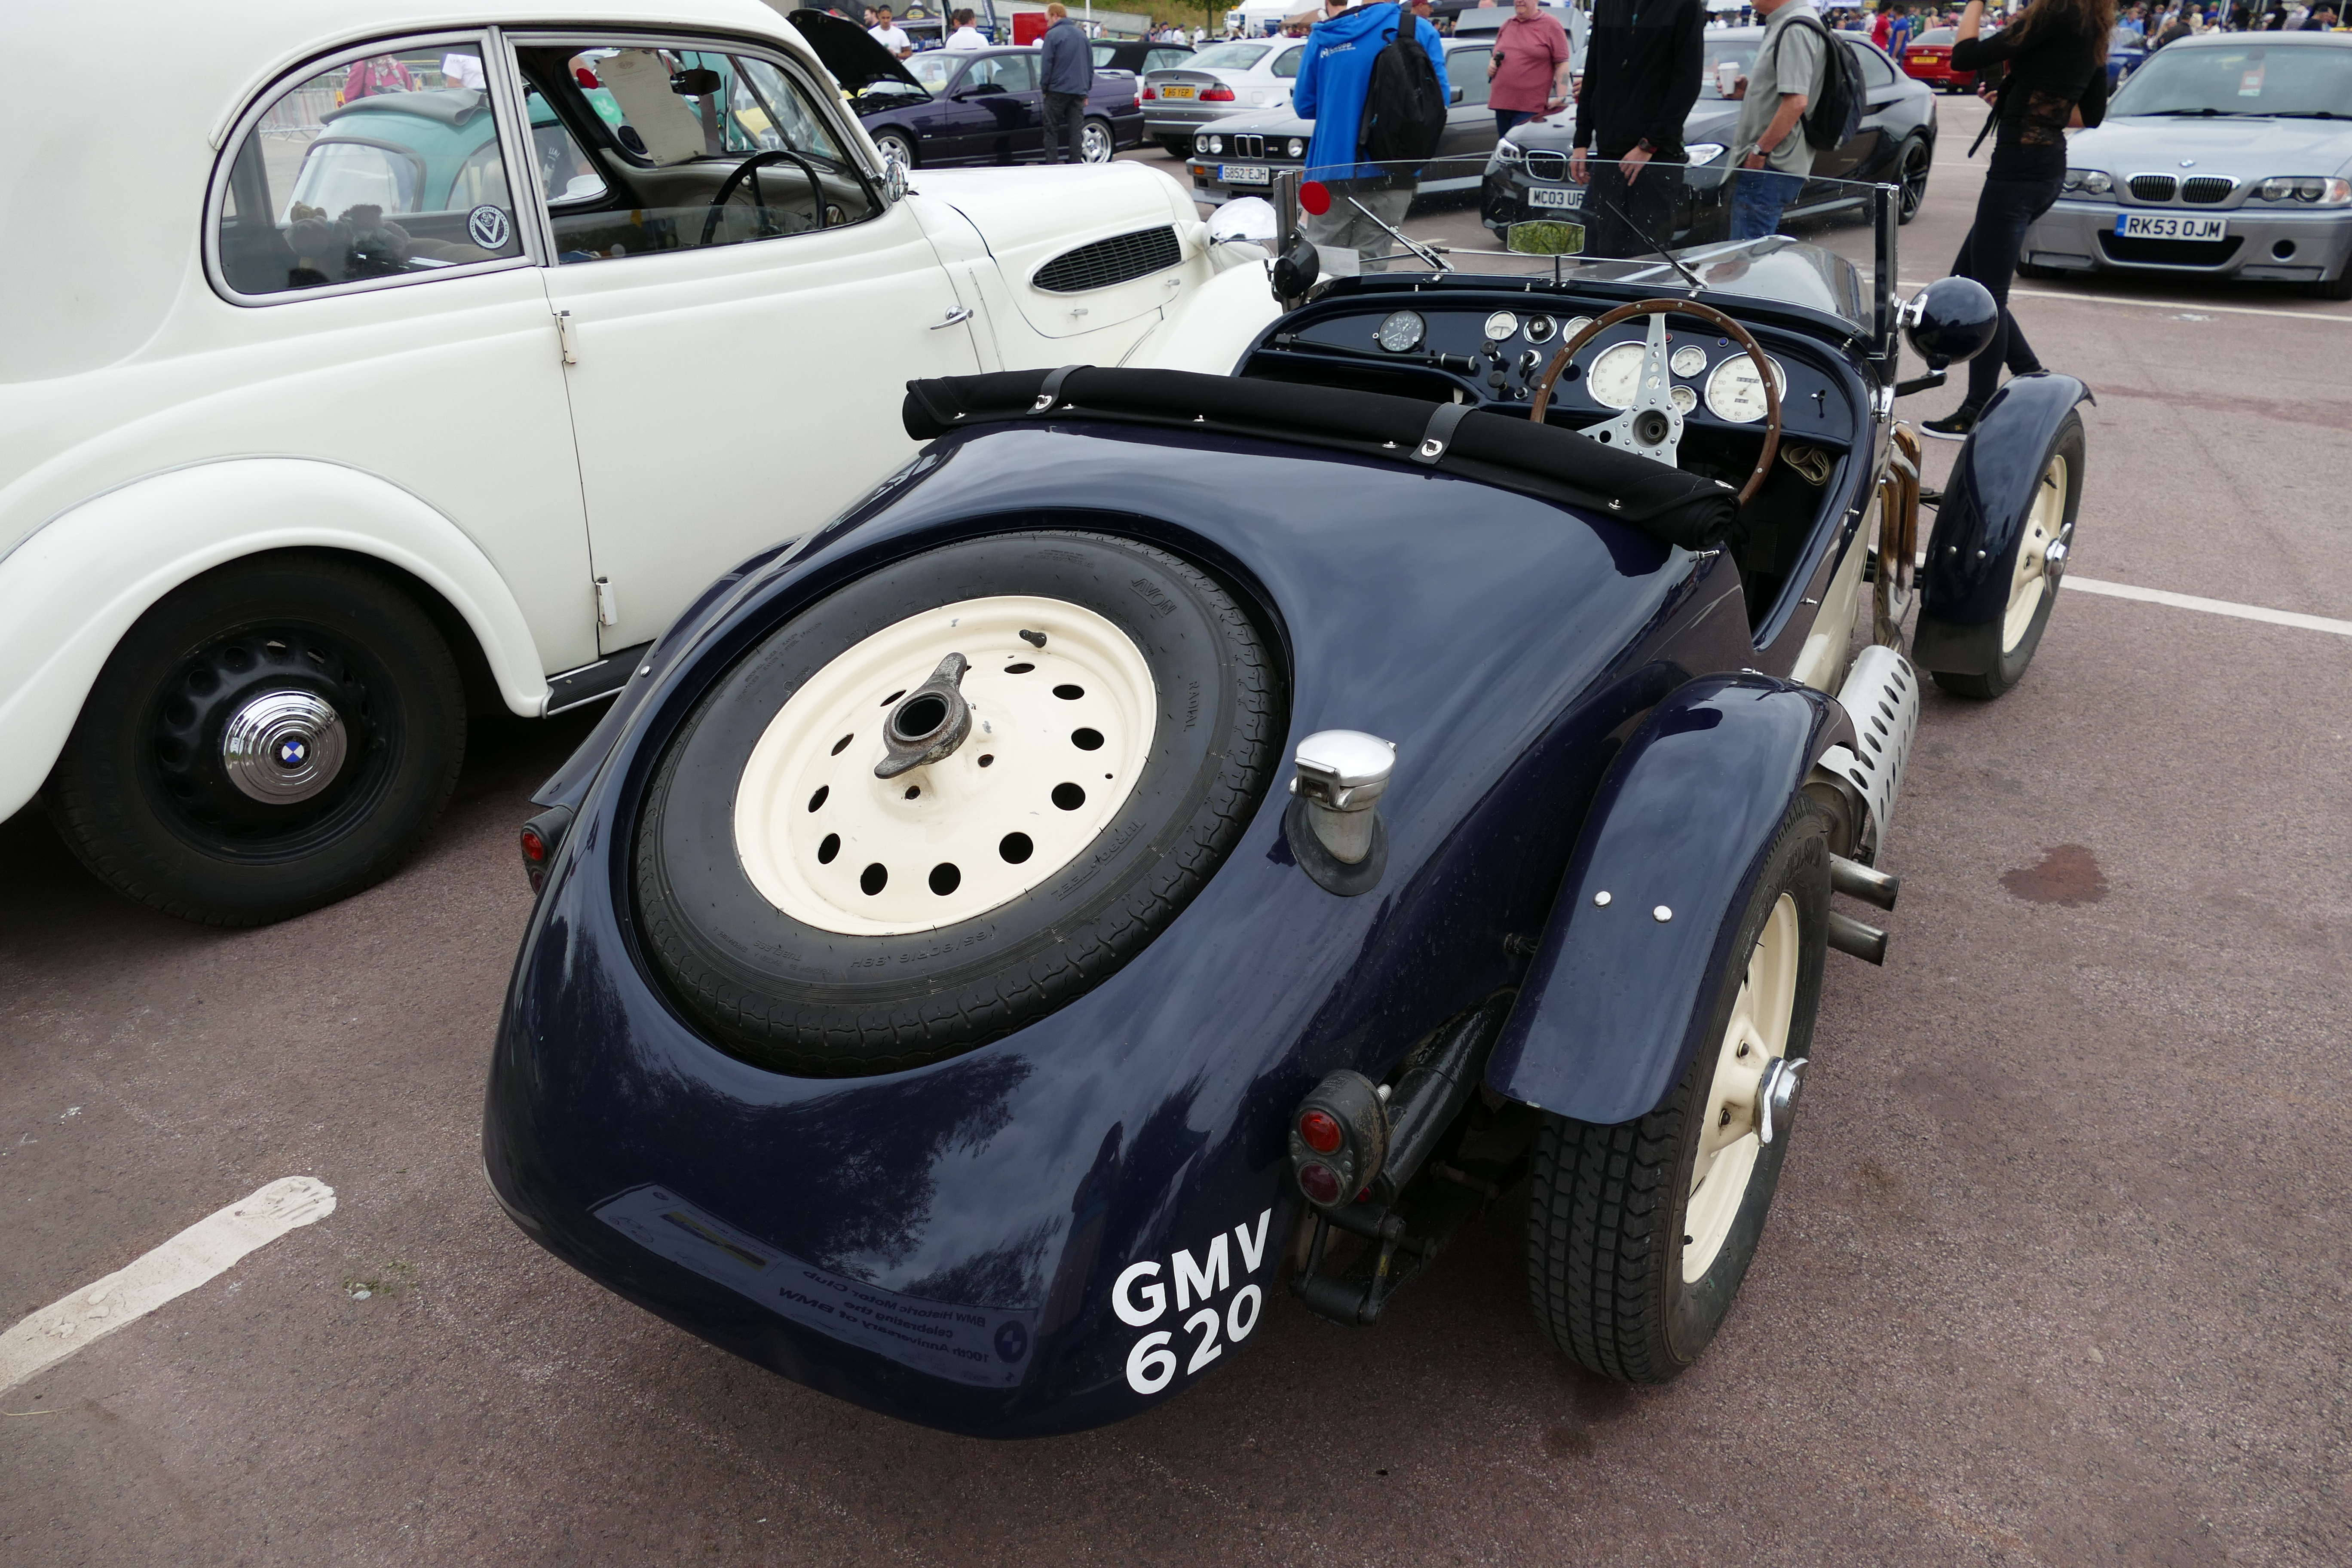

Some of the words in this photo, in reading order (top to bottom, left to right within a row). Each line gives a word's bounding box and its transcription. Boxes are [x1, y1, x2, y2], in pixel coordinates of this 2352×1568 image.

[1225, 167, 1244, 179] G852
[1249, 168, 1267, 180] EJH
[2128, 218, 2177, 235] RK53
[1132, 579, 1177, 615] AVON
[844, 629, 861, 643] DOT
[1182, 680, 1200, 732] RADIAL
[753, 940, 802, 961] TUBELESS
[850, 957, 887, 968] 88H
[1112, 1208, 1271, 1327] GMV
[1126, 1284, 1262, 1395] 620
